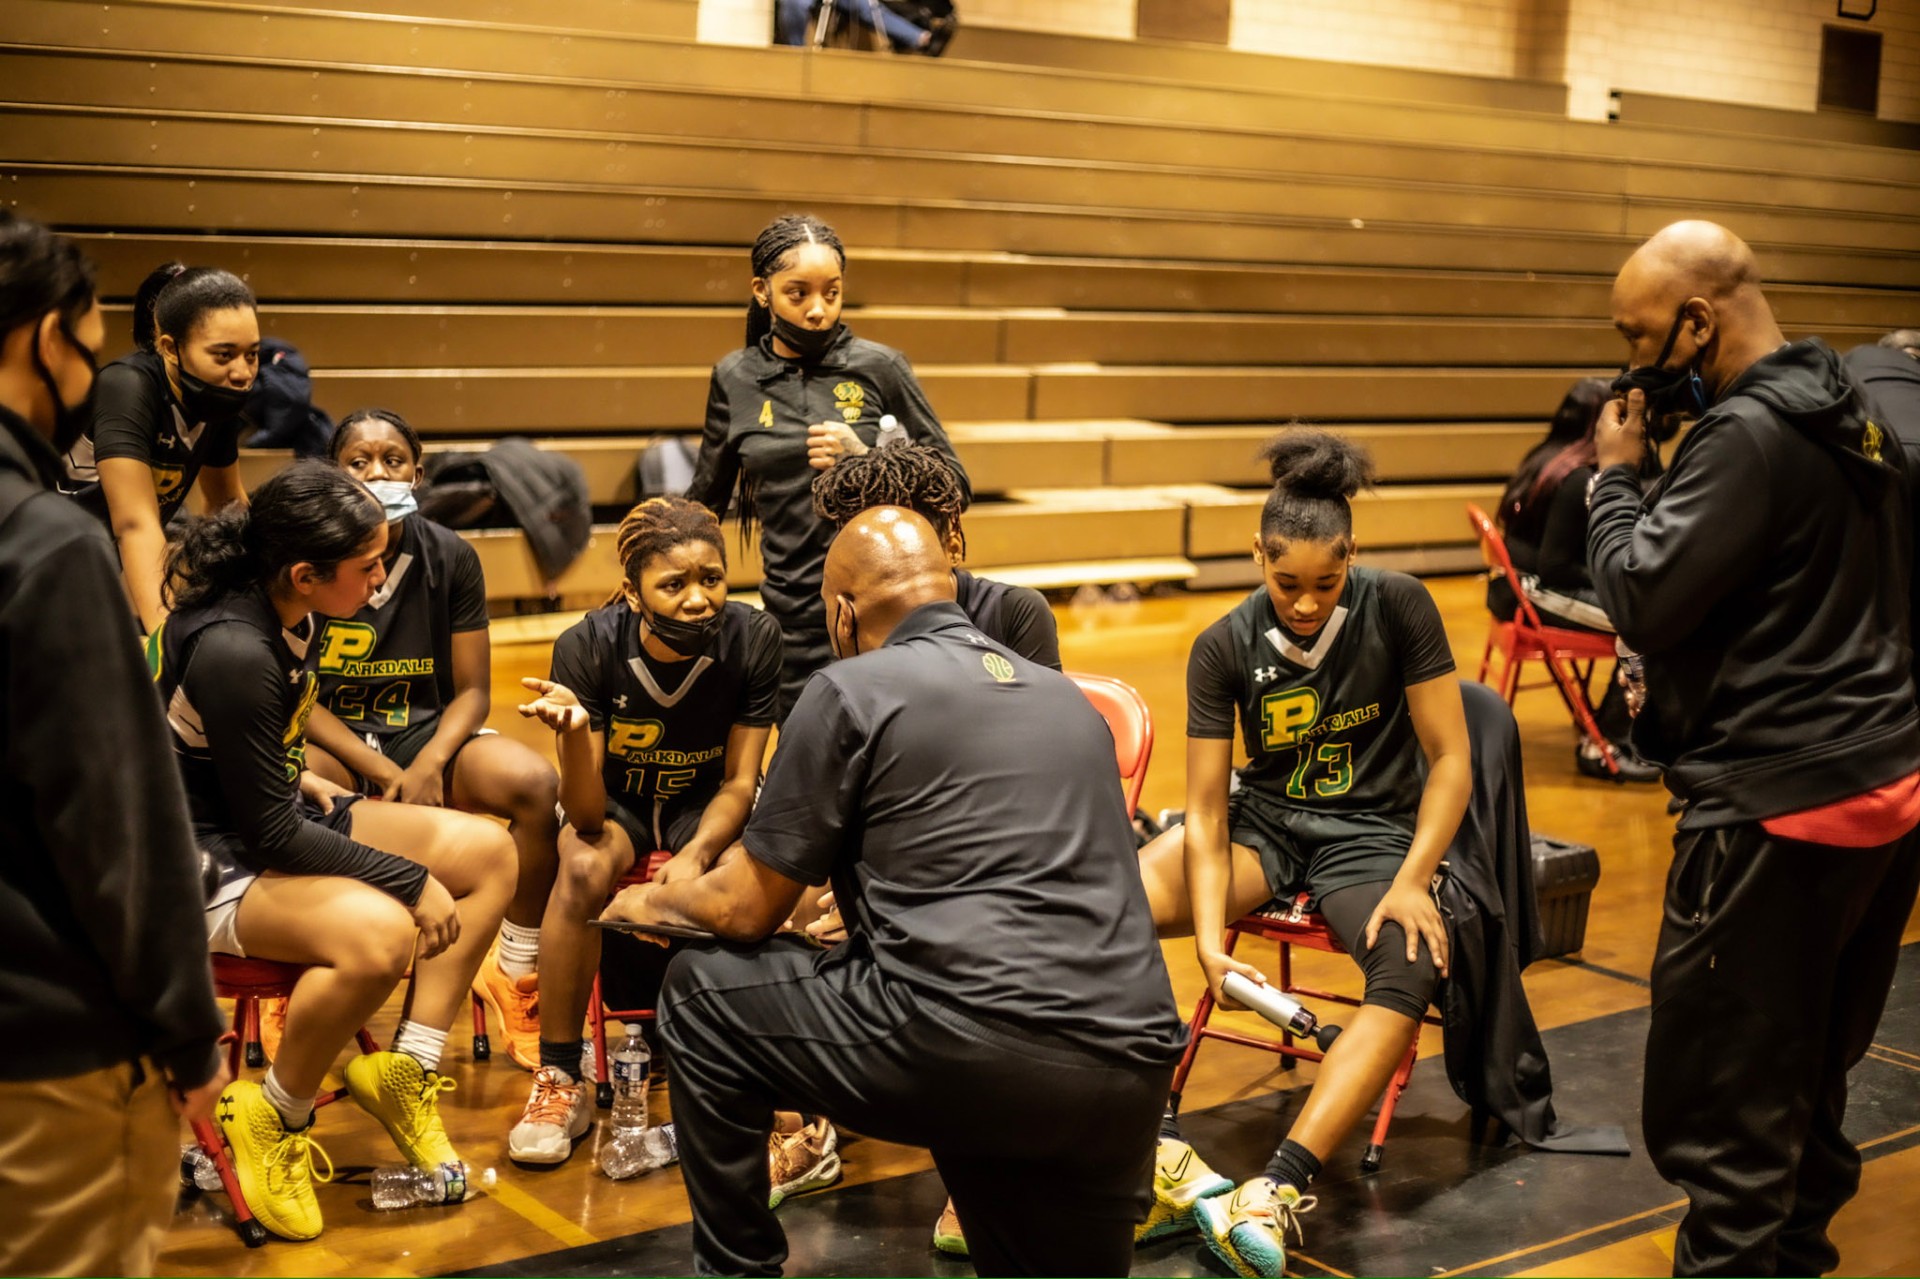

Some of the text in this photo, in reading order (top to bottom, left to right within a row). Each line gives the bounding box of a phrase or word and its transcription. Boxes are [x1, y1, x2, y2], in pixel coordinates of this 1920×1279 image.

[758, 399, 775, 428] 4
[319, 620, 433, 676] PARKDALE
[608, 714, 723, 764] PARKDALE
[1286, 741, 1353, 799] 13
